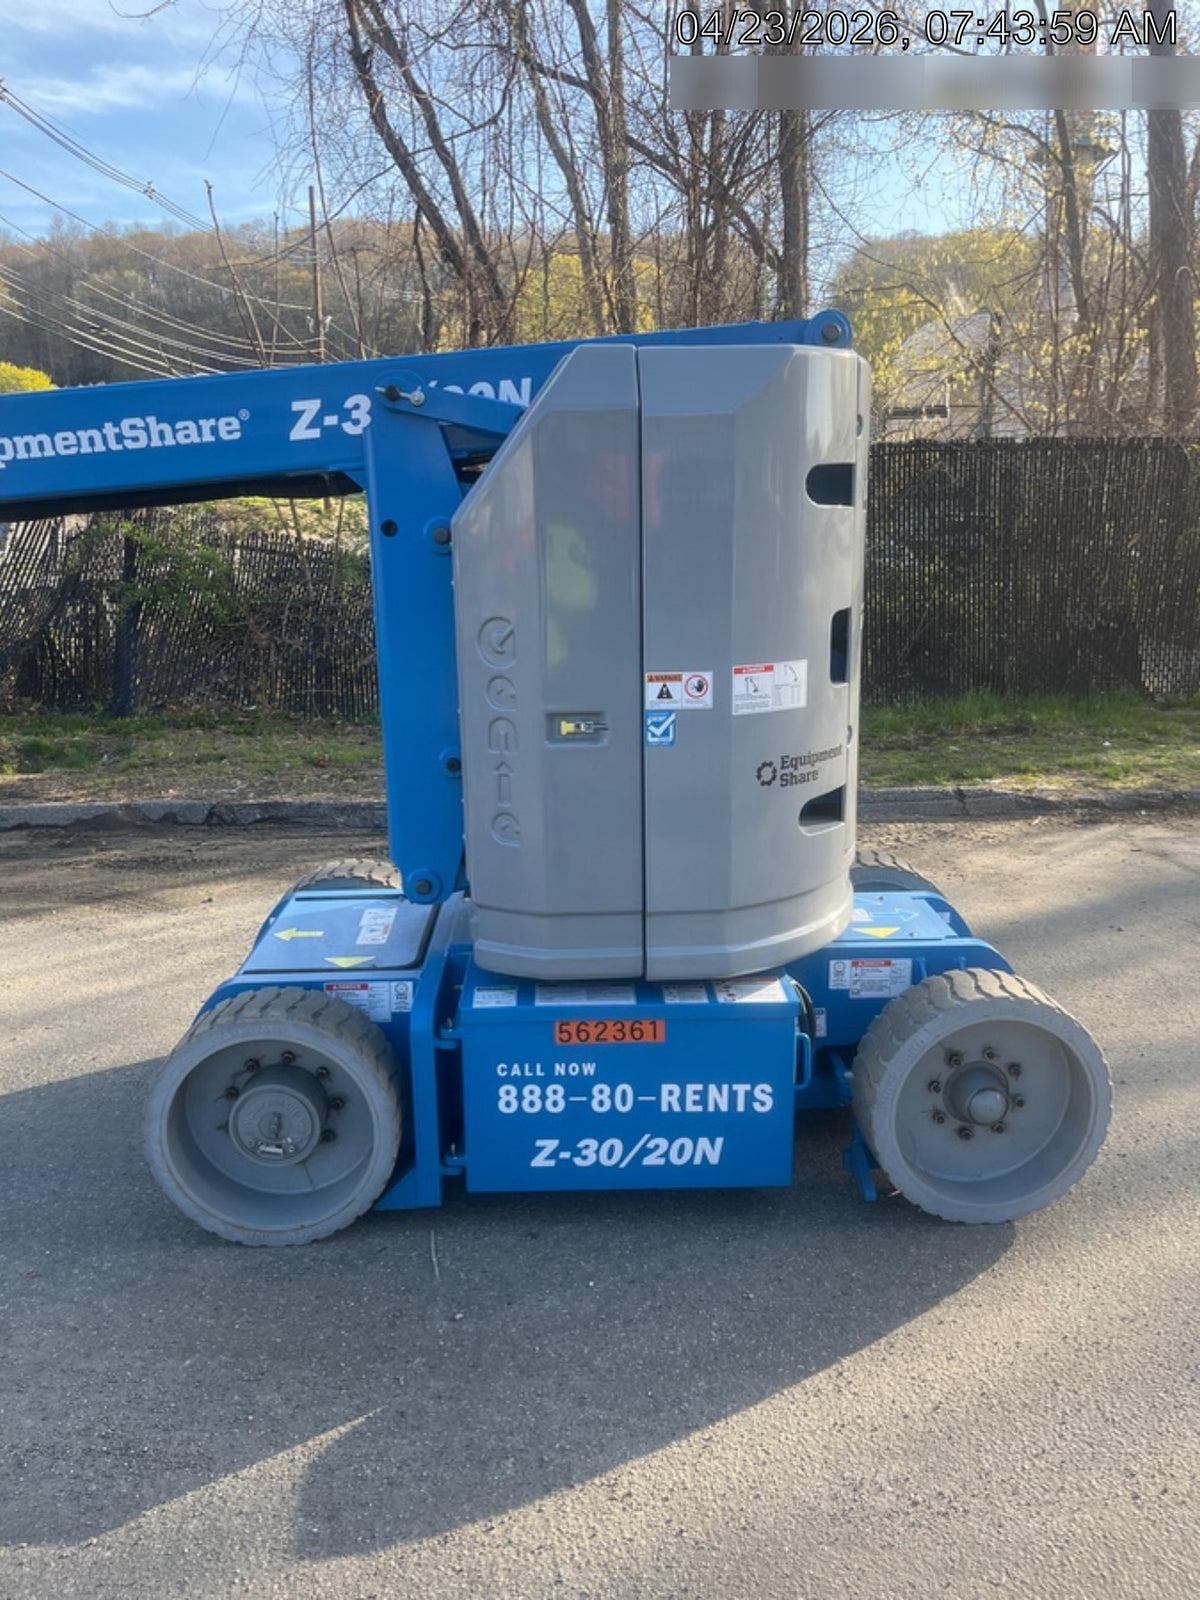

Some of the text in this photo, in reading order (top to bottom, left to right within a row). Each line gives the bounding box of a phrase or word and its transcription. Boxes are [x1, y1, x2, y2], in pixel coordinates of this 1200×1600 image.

[780, 744, 843, 770] Equipment
[780, 769, 819, 788] Share
[557, 1021, 660, 1043] 562361
[496, 1062, 597, 1077] CALL NOW
[497, 1083, 774, 1114] 888-80-RENTS
[529, 1133, 724, 1169] Z-30/20N
